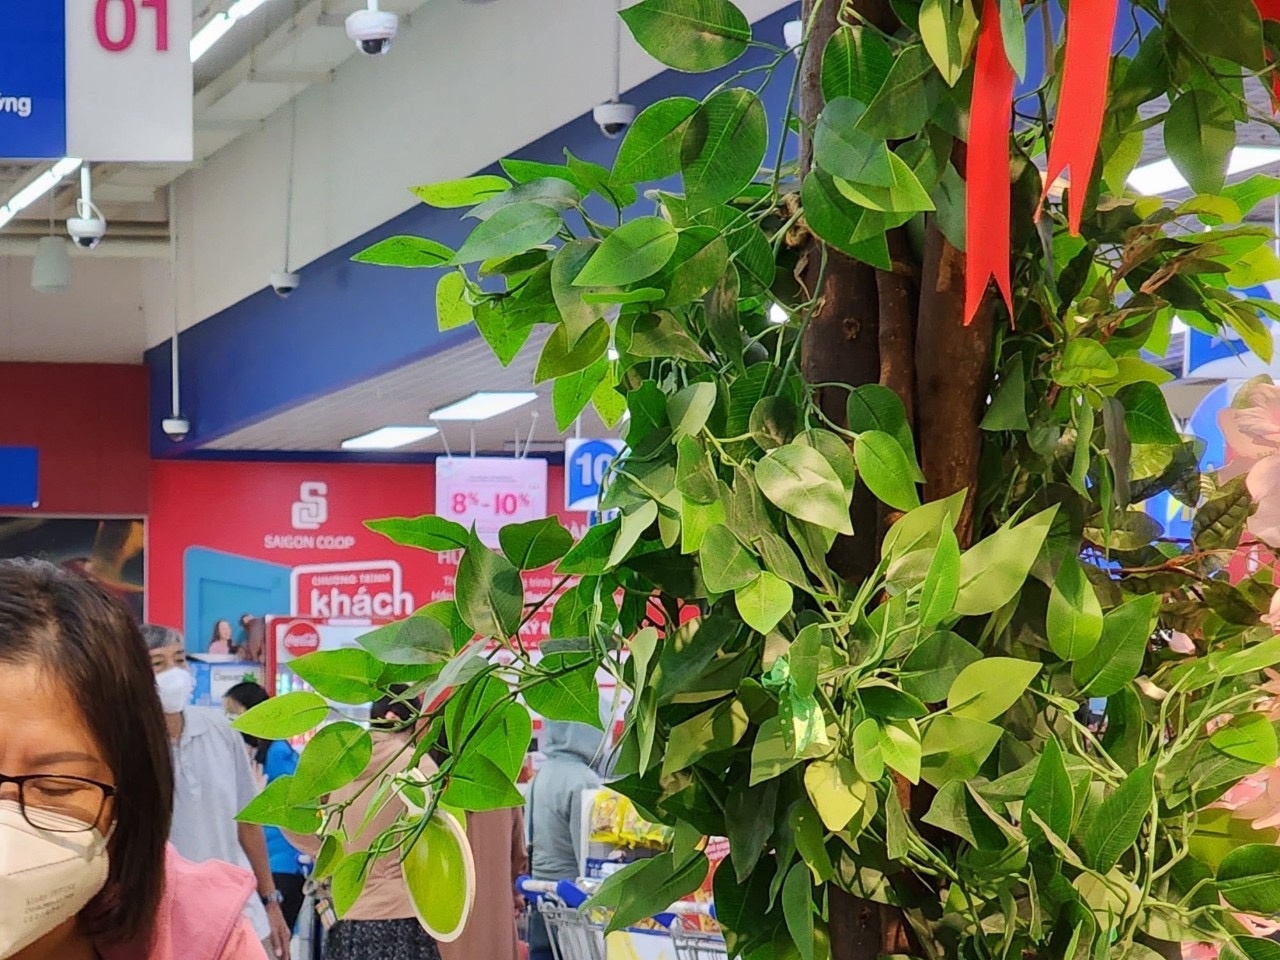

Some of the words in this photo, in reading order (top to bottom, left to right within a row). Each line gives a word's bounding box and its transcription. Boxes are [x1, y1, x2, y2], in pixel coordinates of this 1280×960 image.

[94, 0, 169, 52] 01
[576, 452, 612, 486] 10
[264, 534, 314, 549] SAIGON
[311, 586, 414, 617] khách
